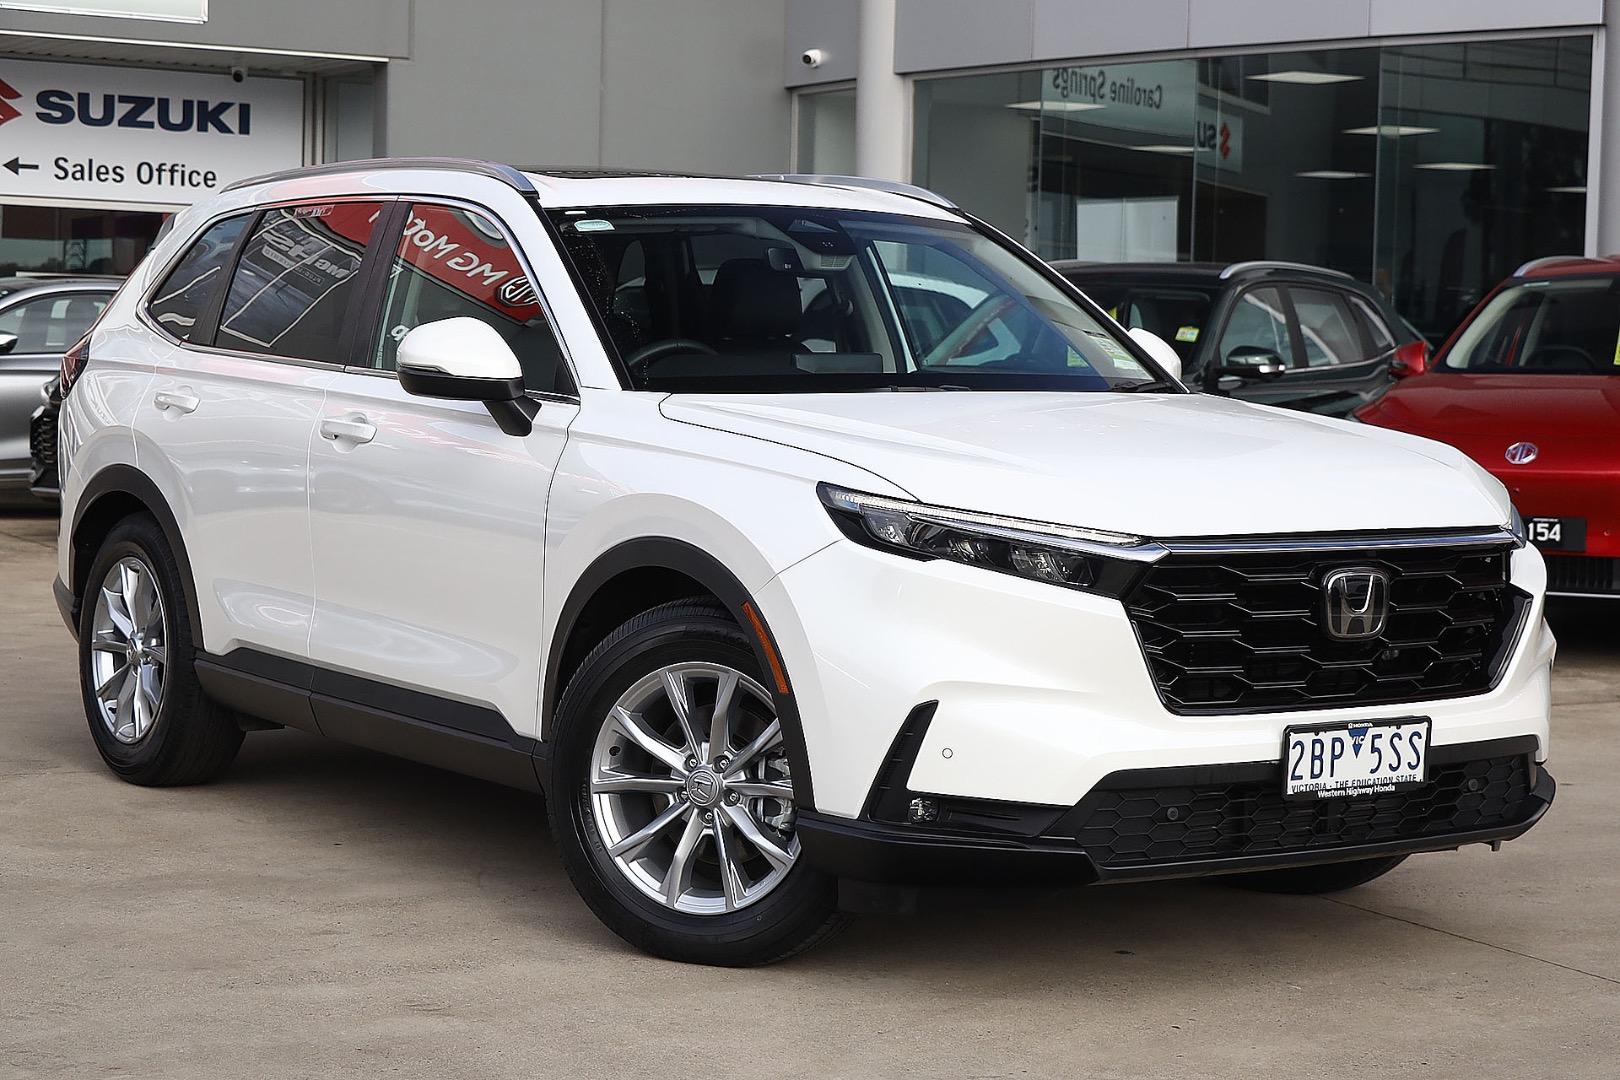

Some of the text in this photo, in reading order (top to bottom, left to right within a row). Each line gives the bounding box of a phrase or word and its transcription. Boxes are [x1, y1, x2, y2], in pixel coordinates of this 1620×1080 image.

[35, 89, 251, 136] SUZUKI
[53, 156, 217, 188] Sales Office
[1528, 522, 1561, 542] 154
[1290, 731, 1423, 781] 2BP 5SS
[1291, 782, 1327, 793] VICTORIA
[1335, 780, 1349, 789] THE
[1352, 776, 1393, 787] EDUCATION
[1395, 774, 1417, 783] STATE
[1317, 784, 1395, 798] Western Highway Honda
